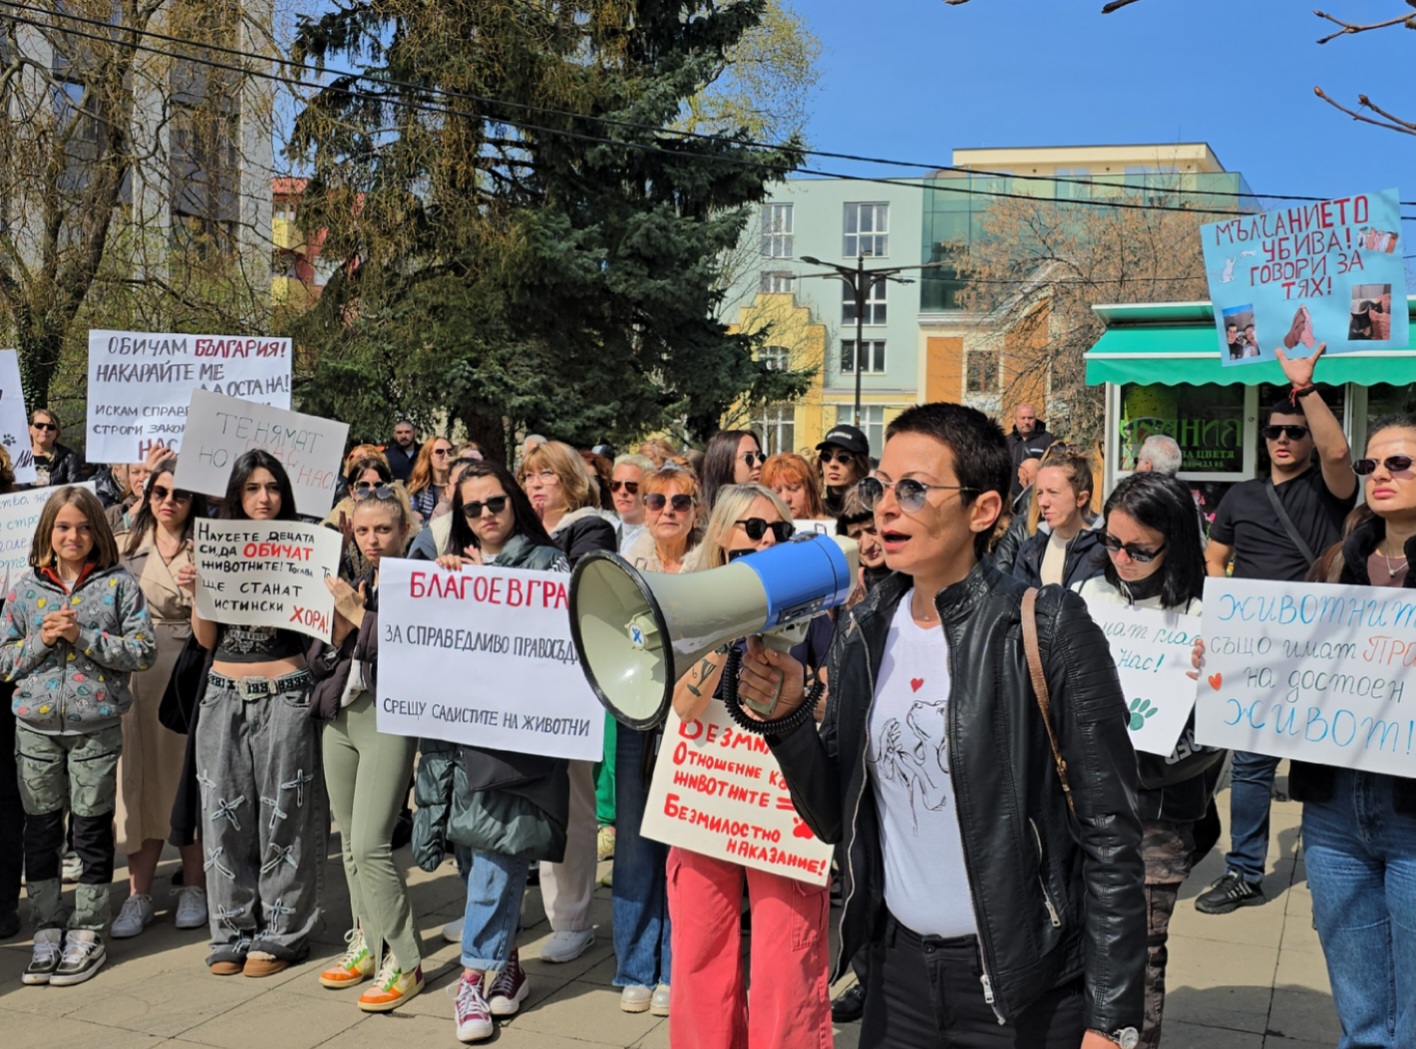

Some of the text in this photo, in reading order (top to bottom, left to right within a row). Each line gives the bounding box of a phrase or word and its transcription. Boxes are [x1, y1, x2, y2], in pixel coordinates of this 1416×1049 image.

[1216, 195, 1368, 246] МЪЛЧАНИЕТО
[1262, 228, 1351, 262] УБИВА!
[1251, 250, 1364, 286] ГОВОРИ ЗА
[1281, 277, 1332, 300] ТЯХ!
[108, 337, 287, 358] ОБИЧАМ БЪЛГАРИЯ!
[96, 360, 224, 382] НАКАРАЙТЕ МЕ
[95, 405, 139, 417] ИСКАМ
[93, 424, 143, 435] СТРОГИ
[199, 446, 228, 468] НО
[243, 543, 313, 561] ОБИЧАТ
[266, 532, 315, 543] ДЕЦАТА
[202, 561, 283, 572] ЖИВОТНИТЕ!
[203, 579, 302, 597] ЩЕ СТАНАТ
[410, 571, 569, 609] БЛАГОЕВГРА
[215, 599, 329, 634] ИСТИНСКИ ХОРА!
[385, 624, 509, 653] ЗА СПРАВЕДЛИВО
[1243, 667, 1404, 703] на достоен
[383, 698, 591, 736] СРЕЩУ САДИСТИТЕ НА ЖИВОТНИ
[673, 742, 761, 779] ОТНОШЕНИЕ
[674, 771, 770, 808] ЖИВОТНИТЕ
[664, 794, 780, 843] БЕЗМИЛОСТНО
[726, 838, 826, 877] НАКАЗАНИЕ!
